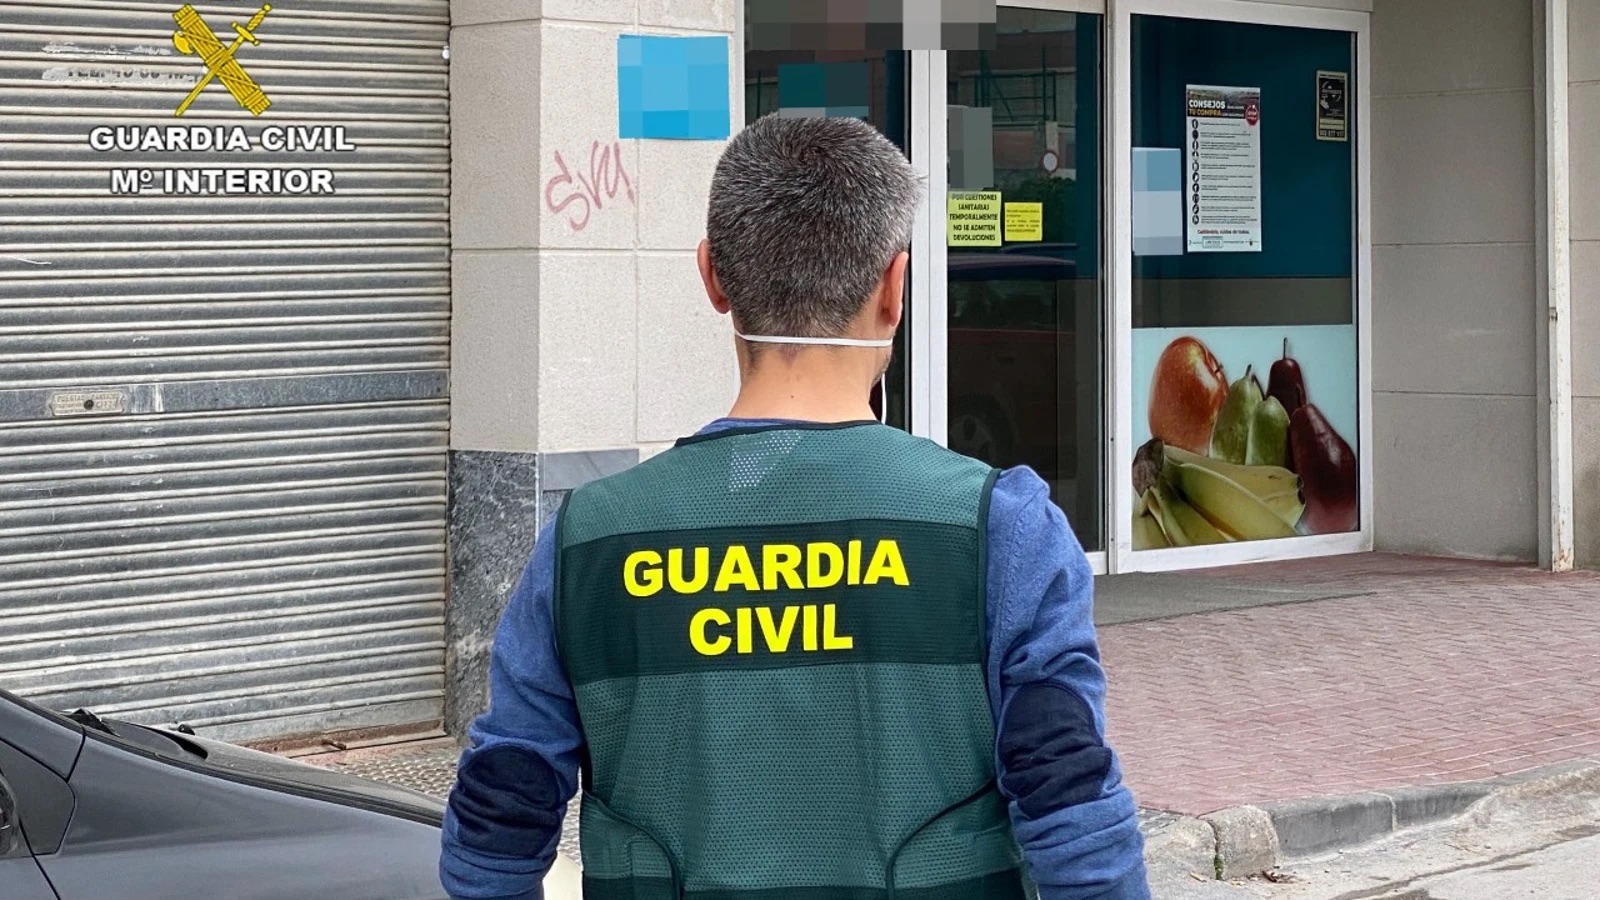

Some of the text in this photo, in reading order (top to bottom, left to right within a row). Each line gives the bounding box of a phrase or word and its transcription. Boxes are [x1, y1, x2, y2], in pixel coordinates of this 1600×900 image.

[1188, 100, 1226, 109] CONSEJOS
[1197, 109, 1222, 117] COMPRA
[952, 193, 997, 201] POR CUESTIONES
[958, 203, 990, 211] SANITARIAS
[623, 539, 910, 656] GUARDIA CIVIL
